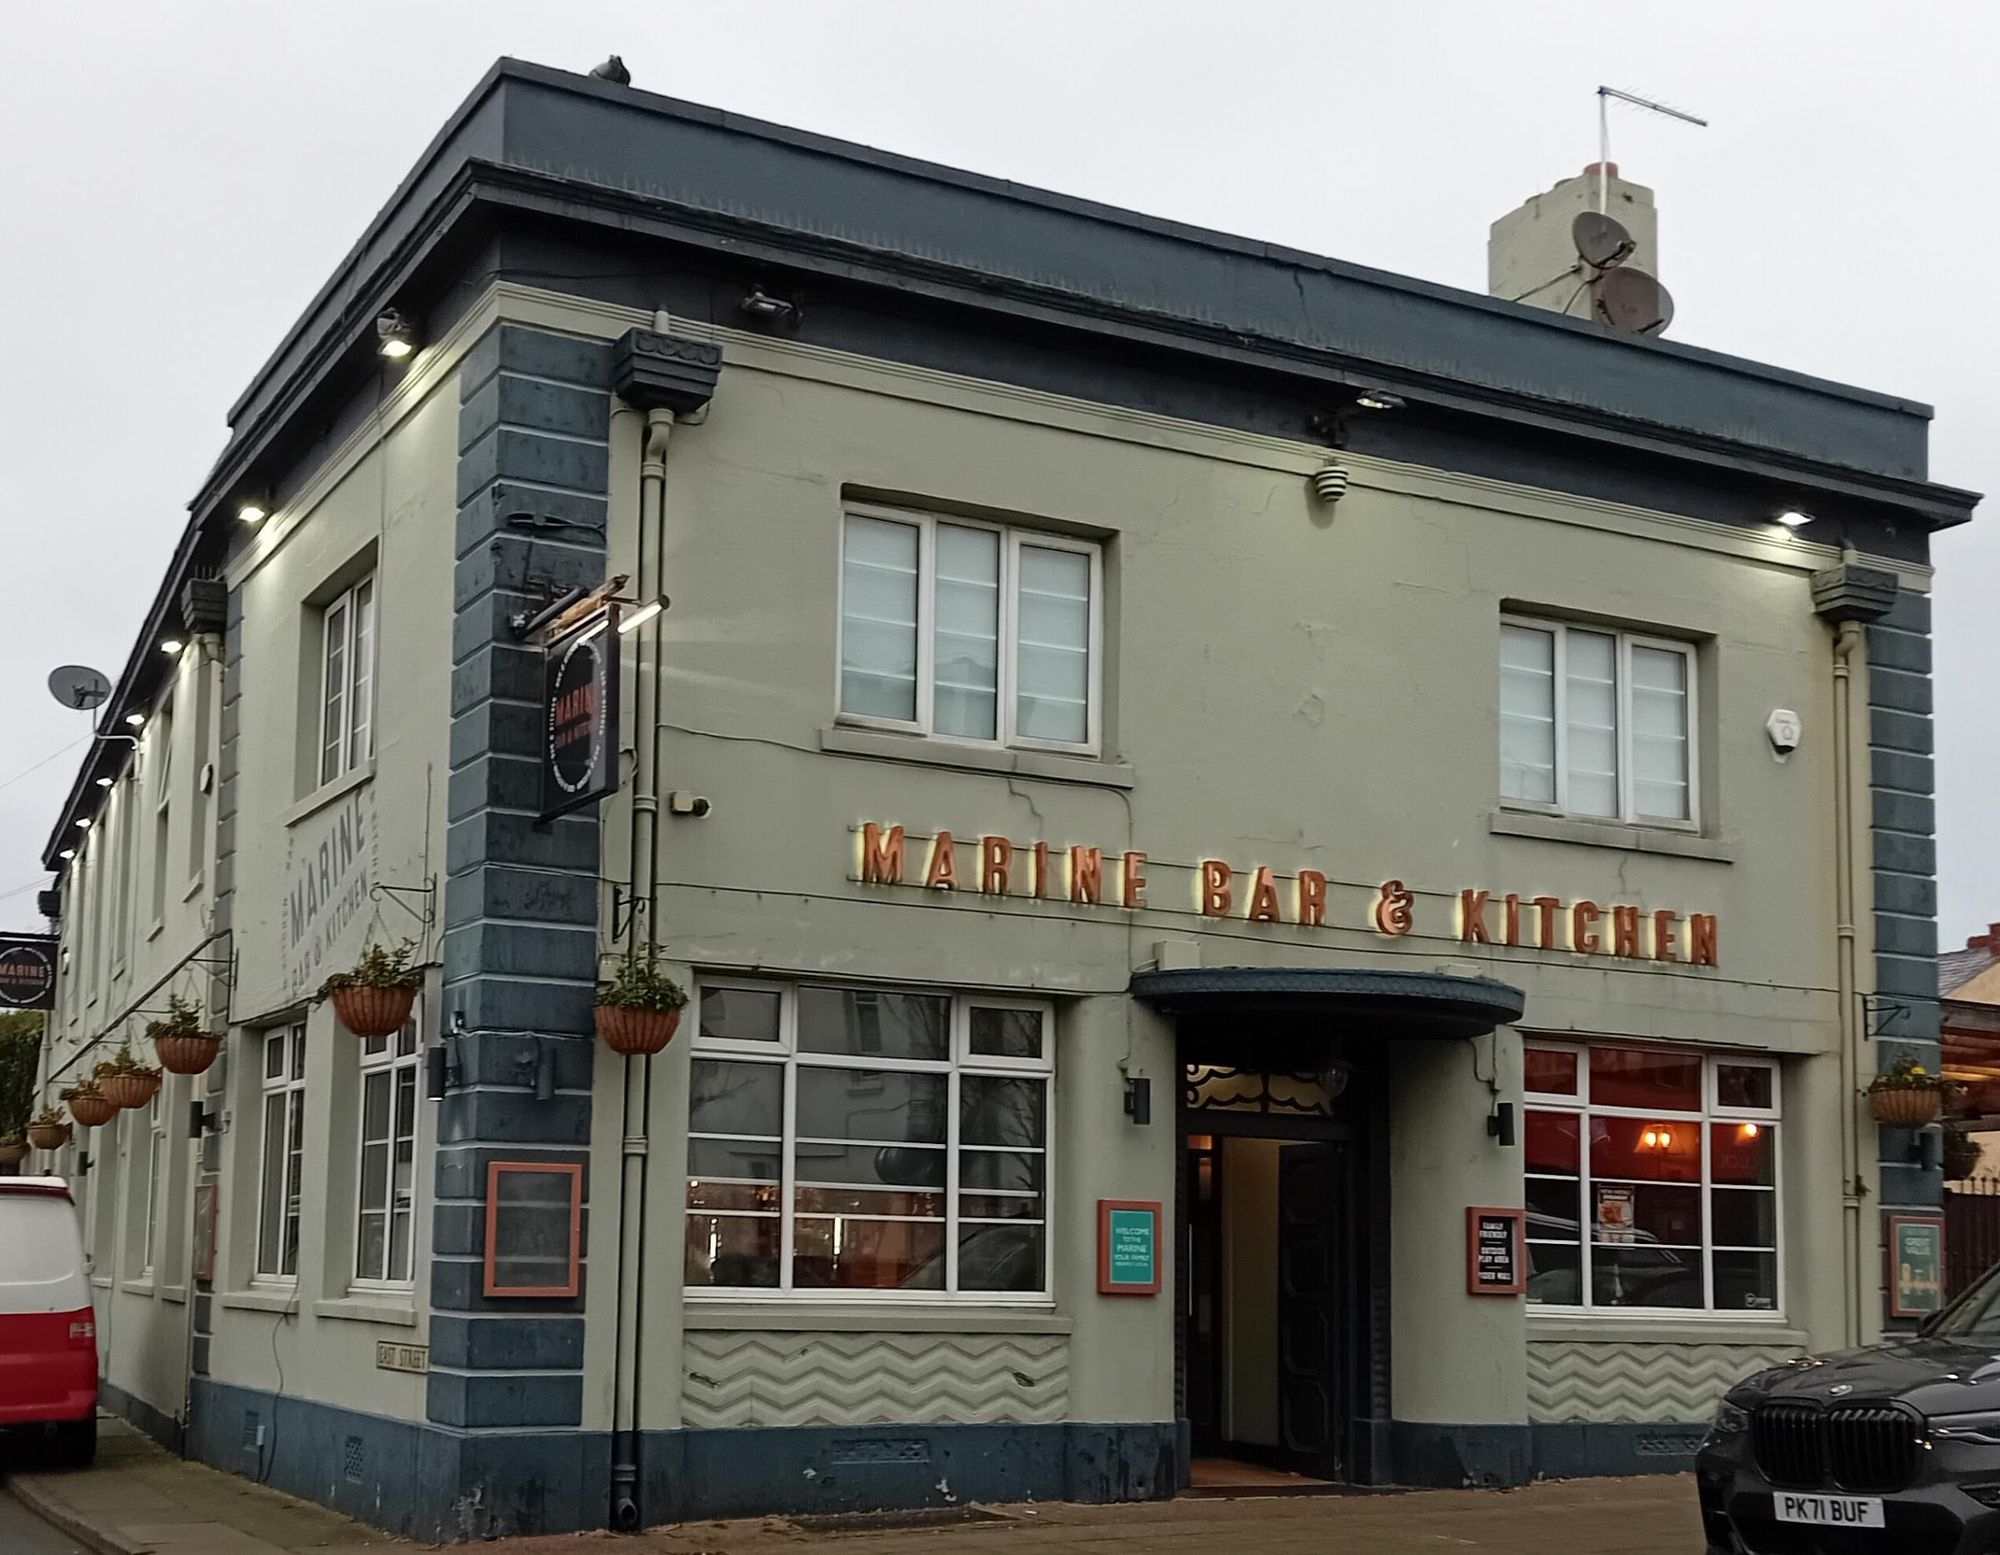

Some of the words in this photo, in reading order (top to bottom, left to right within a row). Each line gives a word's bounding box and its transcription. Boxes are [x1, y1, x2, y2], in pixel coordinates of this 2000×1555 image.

[555, 681, 600, 729] MARIN
[291, 787, 365, 949] MARINE
[862, 821, 1149, 909] MARINE
[1201, 859, 1327, 927] BAR
[1375, 878, 1415, 936] &
[1460, 888, 1718, 967] KITCHEN
[325, 867, 368, 951] KITCHEN
[0, 962, 46, 978] MARINE
[1115, 1227, 1150, 1236] WELCOME
[1116, 1244, 1148, 1253] MARINE
[379, 1345, 396, 1366] EAST
[399, 1348, 426, 1370] STREET
[1785, 1497, 1826, 1520] PK71
[1830, 1500, 1869, 1523] BUF
